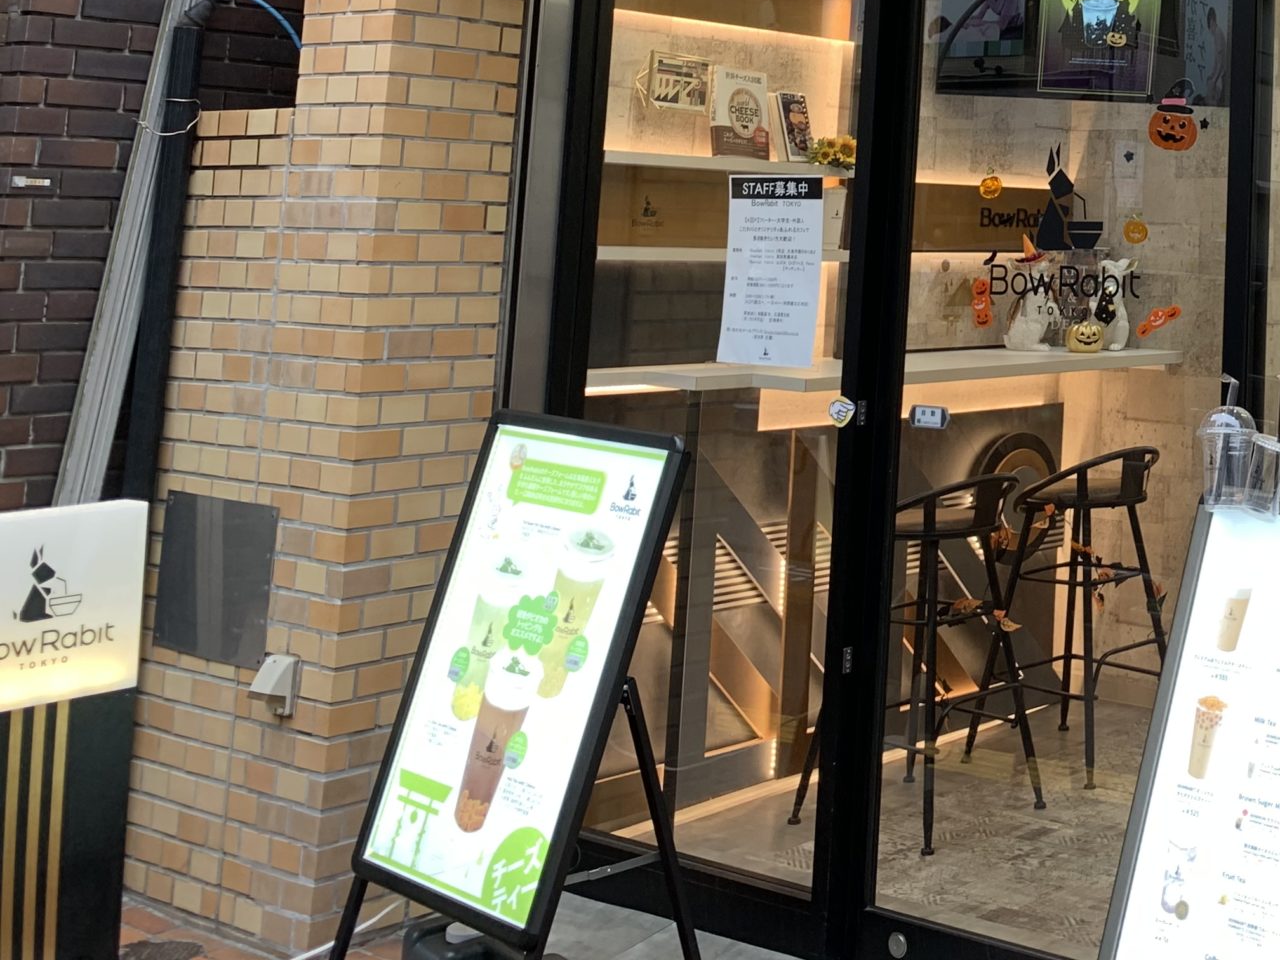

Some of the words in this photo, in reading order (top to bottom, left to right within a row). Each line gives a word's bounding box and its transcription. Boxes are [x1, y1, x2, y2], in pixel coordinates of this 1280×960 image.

[730, 105, 759, 117] CHEESE
[735, 115, 754, 124] BOOK
[742, 181, 808, 197] STAFF募集中
[989, 264, 1142, 299] BowRabit
[0, 622, 115, 660] owRabit
[19, 655, 68, 670] TOKYO
[492, 838, 547, 888] チーズ
